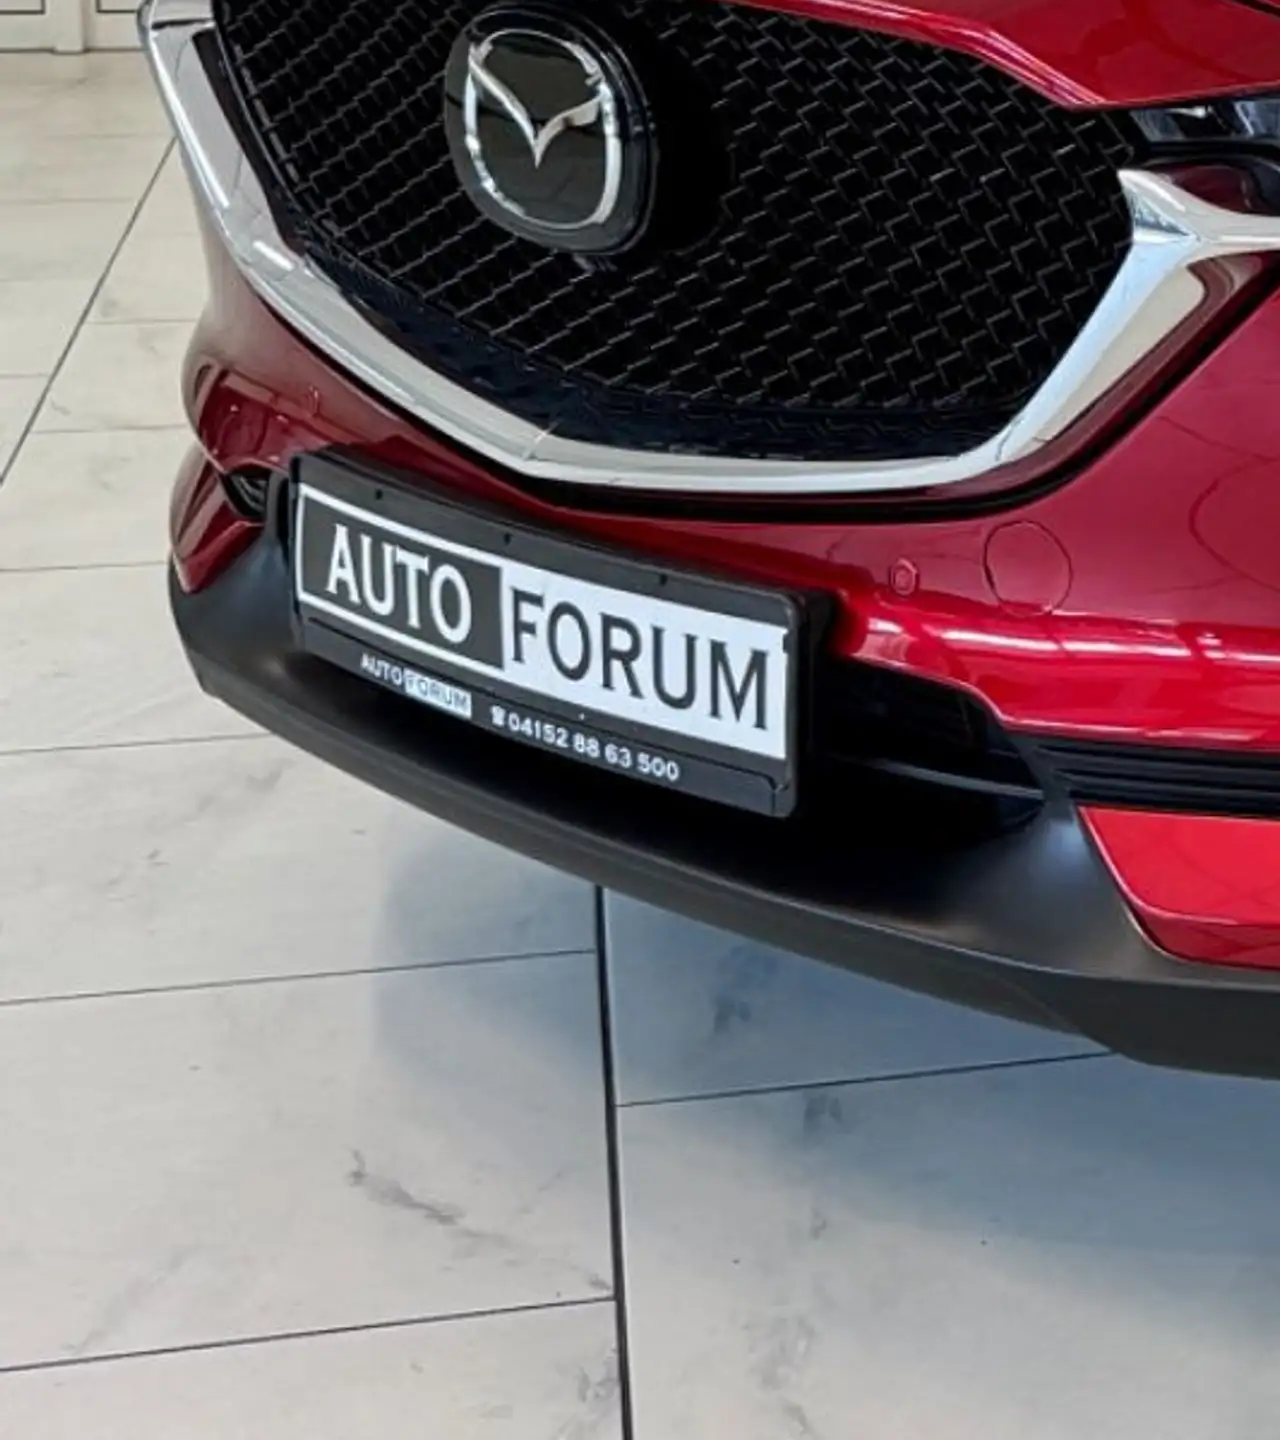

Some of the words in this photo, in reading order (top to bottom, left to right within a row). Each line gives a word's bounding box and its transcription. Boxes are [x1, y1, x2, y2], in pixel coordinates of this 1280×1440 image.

[326, 522, 472, 644] AUTO
[509, 586, 769, 731] FORUM
[508, 712, 568, 748] 04152
[572, 732, 600, 758] 88
[604, 743, 632, 768] 63
[636, 752, 680, 781] 500
